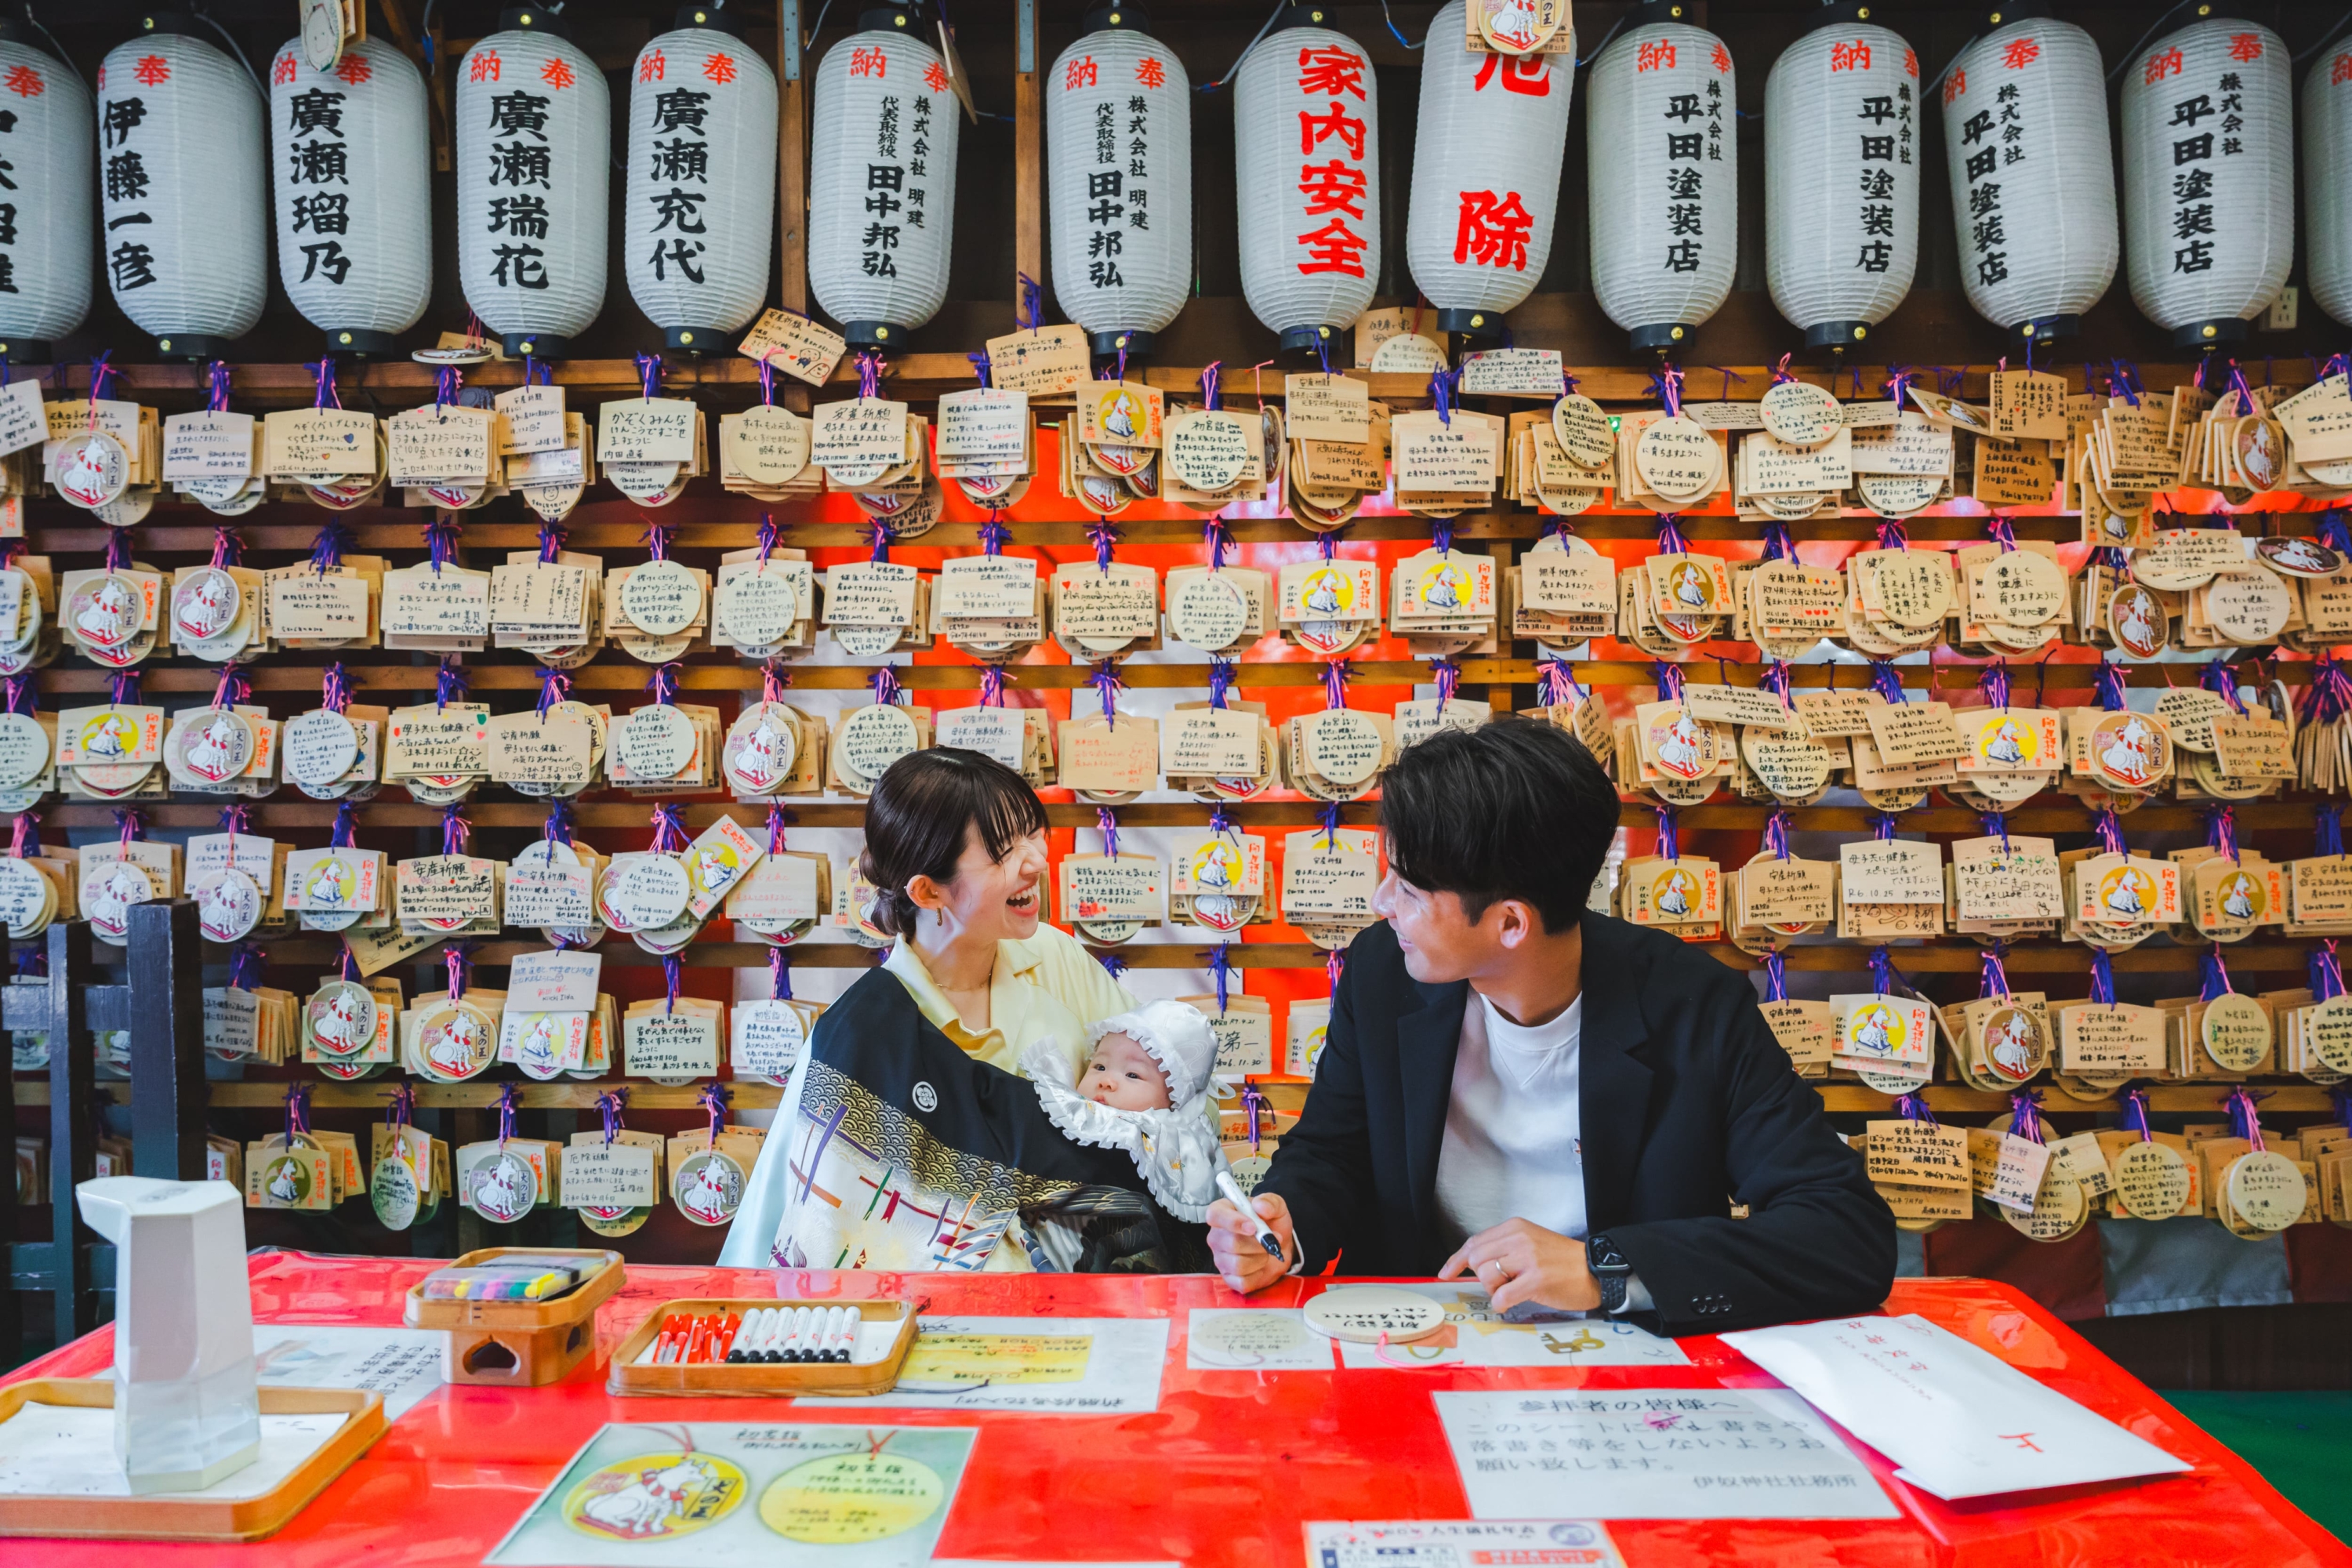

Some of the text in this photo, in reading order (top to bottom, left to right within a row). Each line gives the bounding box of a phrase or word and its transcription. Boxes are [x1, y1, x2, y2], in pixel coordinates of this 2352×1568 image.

[1707, 80, 1722, 162] 株式会社
[1897, 82, 1912, 165] 株式会社
[2218, 73, 2244, 155] 株式会社
[877, 95, 898, 158] 代表取締役
[1095, 102, 1116, 164] 代表取締役
[1996, 84, 2026, 166] 株式会社
[1298, 44, 1368, 278] 家内安全
[1664, 93, 1704, 273] 平田塗装店
[1857, 95, 1896, 273] 平田塗装店
[2167, 95, 2216, 274] 平田塗装店
[103, 97, 157, 292] 伊藤一彦
[1961, 109, 2009, 286] 平田塗装店
[862, 163, 904, 278] 田中邦弘
[1087, 171, 1123, 288] 田中邦弘
[833, 407, 891, 420] 安産祈願
[1428, 434, 1464, 443] 安産祈願
[419, 582, 462, 591] 安産祈願
[745, 580, 778, 589] 初宮詣り
[1768, 572, 1807, 584] 安産祈願
[1998, 578, 2034, 589] 健康に
[220, 590, 231, 621] 犬の王
[1998, 593, 2059, 604] 育ちますように
[126, 597, 135, 626] 犬の王
[1893, 709, 1925, 719] 安産祈願
[500, 730, 541, 739] 安産祈願
[1702, 728, 1713, 760] 犬の王
[1769, 731, 1807, 742] 初宮詣り
[234, 731, 244, 762] 犬の王
[2151, 733, 2161, 766] 犬の王
[1849, 852, 1918, 864] 母子共に健康で
[413, 862, 466, 876] 安産祈願
[529, 871, 567, 881] 安産祈願
[1769, 869, 1806, 880] 安産祈願
[359, 1004, 368, 1035] 犬の王
[1769, 1008, 1802, 1017] 安産祈願
[2086, 1013, 2127, 1024] 安産祈願
[477, 1026, 488, 1058] 犬の王
[1894, 1127, 1936, 1137] 安産祈願
[1984, 1138, 2029, 1157] 安産祈願
[1518, 1397, 1739, 1412] 参拝者の皆様へ
[1469, 1438, 1825, 1454] 落書き等をしないようお
[1475, 1457, 1674, 1471] 願い致します。
[1693, 1474, 1858, 1489] 伊奴神社社務所
